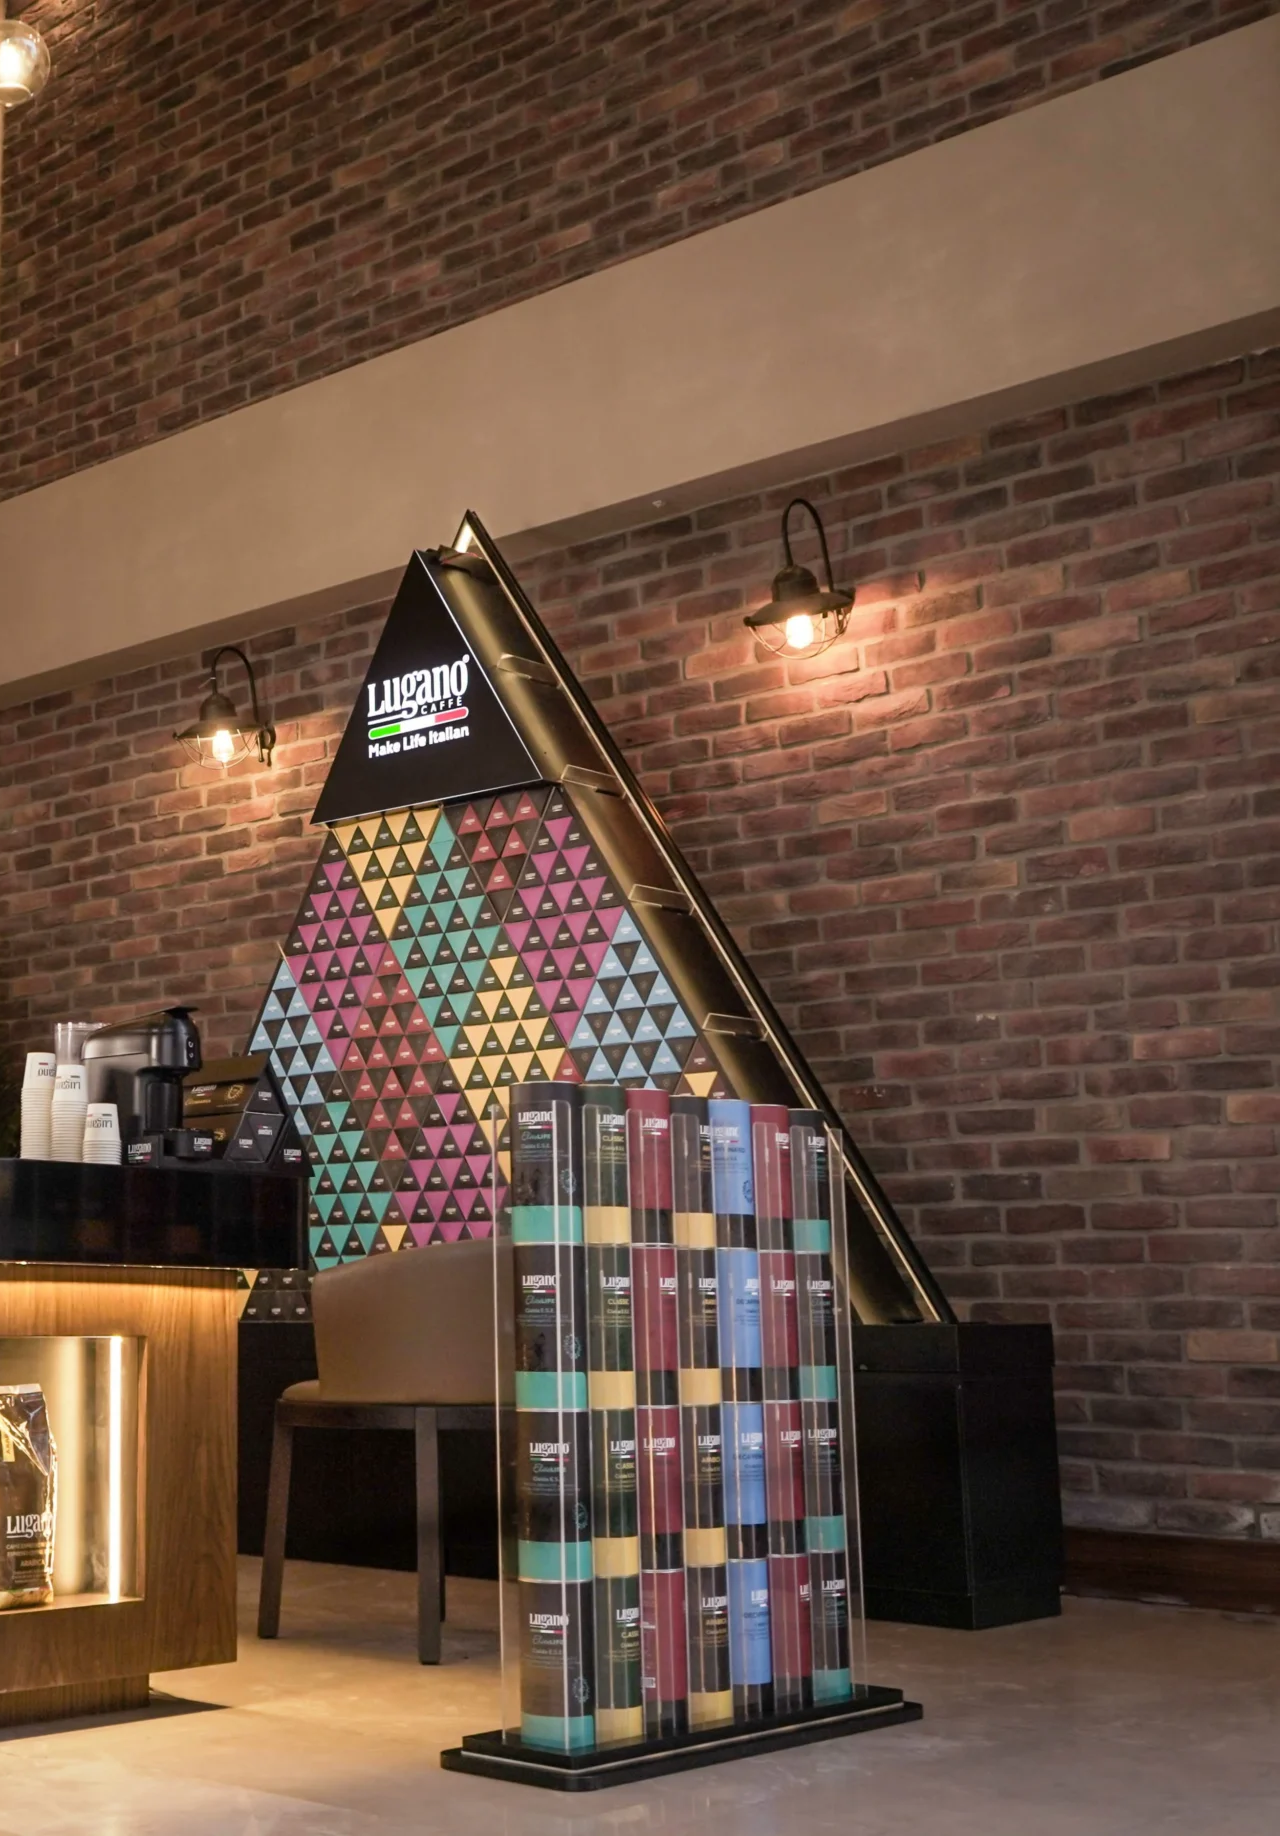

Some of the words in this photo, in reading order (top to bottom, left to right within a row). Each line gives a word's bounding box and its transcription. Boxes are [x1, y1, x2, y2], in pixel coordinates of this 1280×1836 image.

[368, 739, 401, 758] Make
[403, 733, 427, 751] Life
[428, 725, 470, 745] Italian
